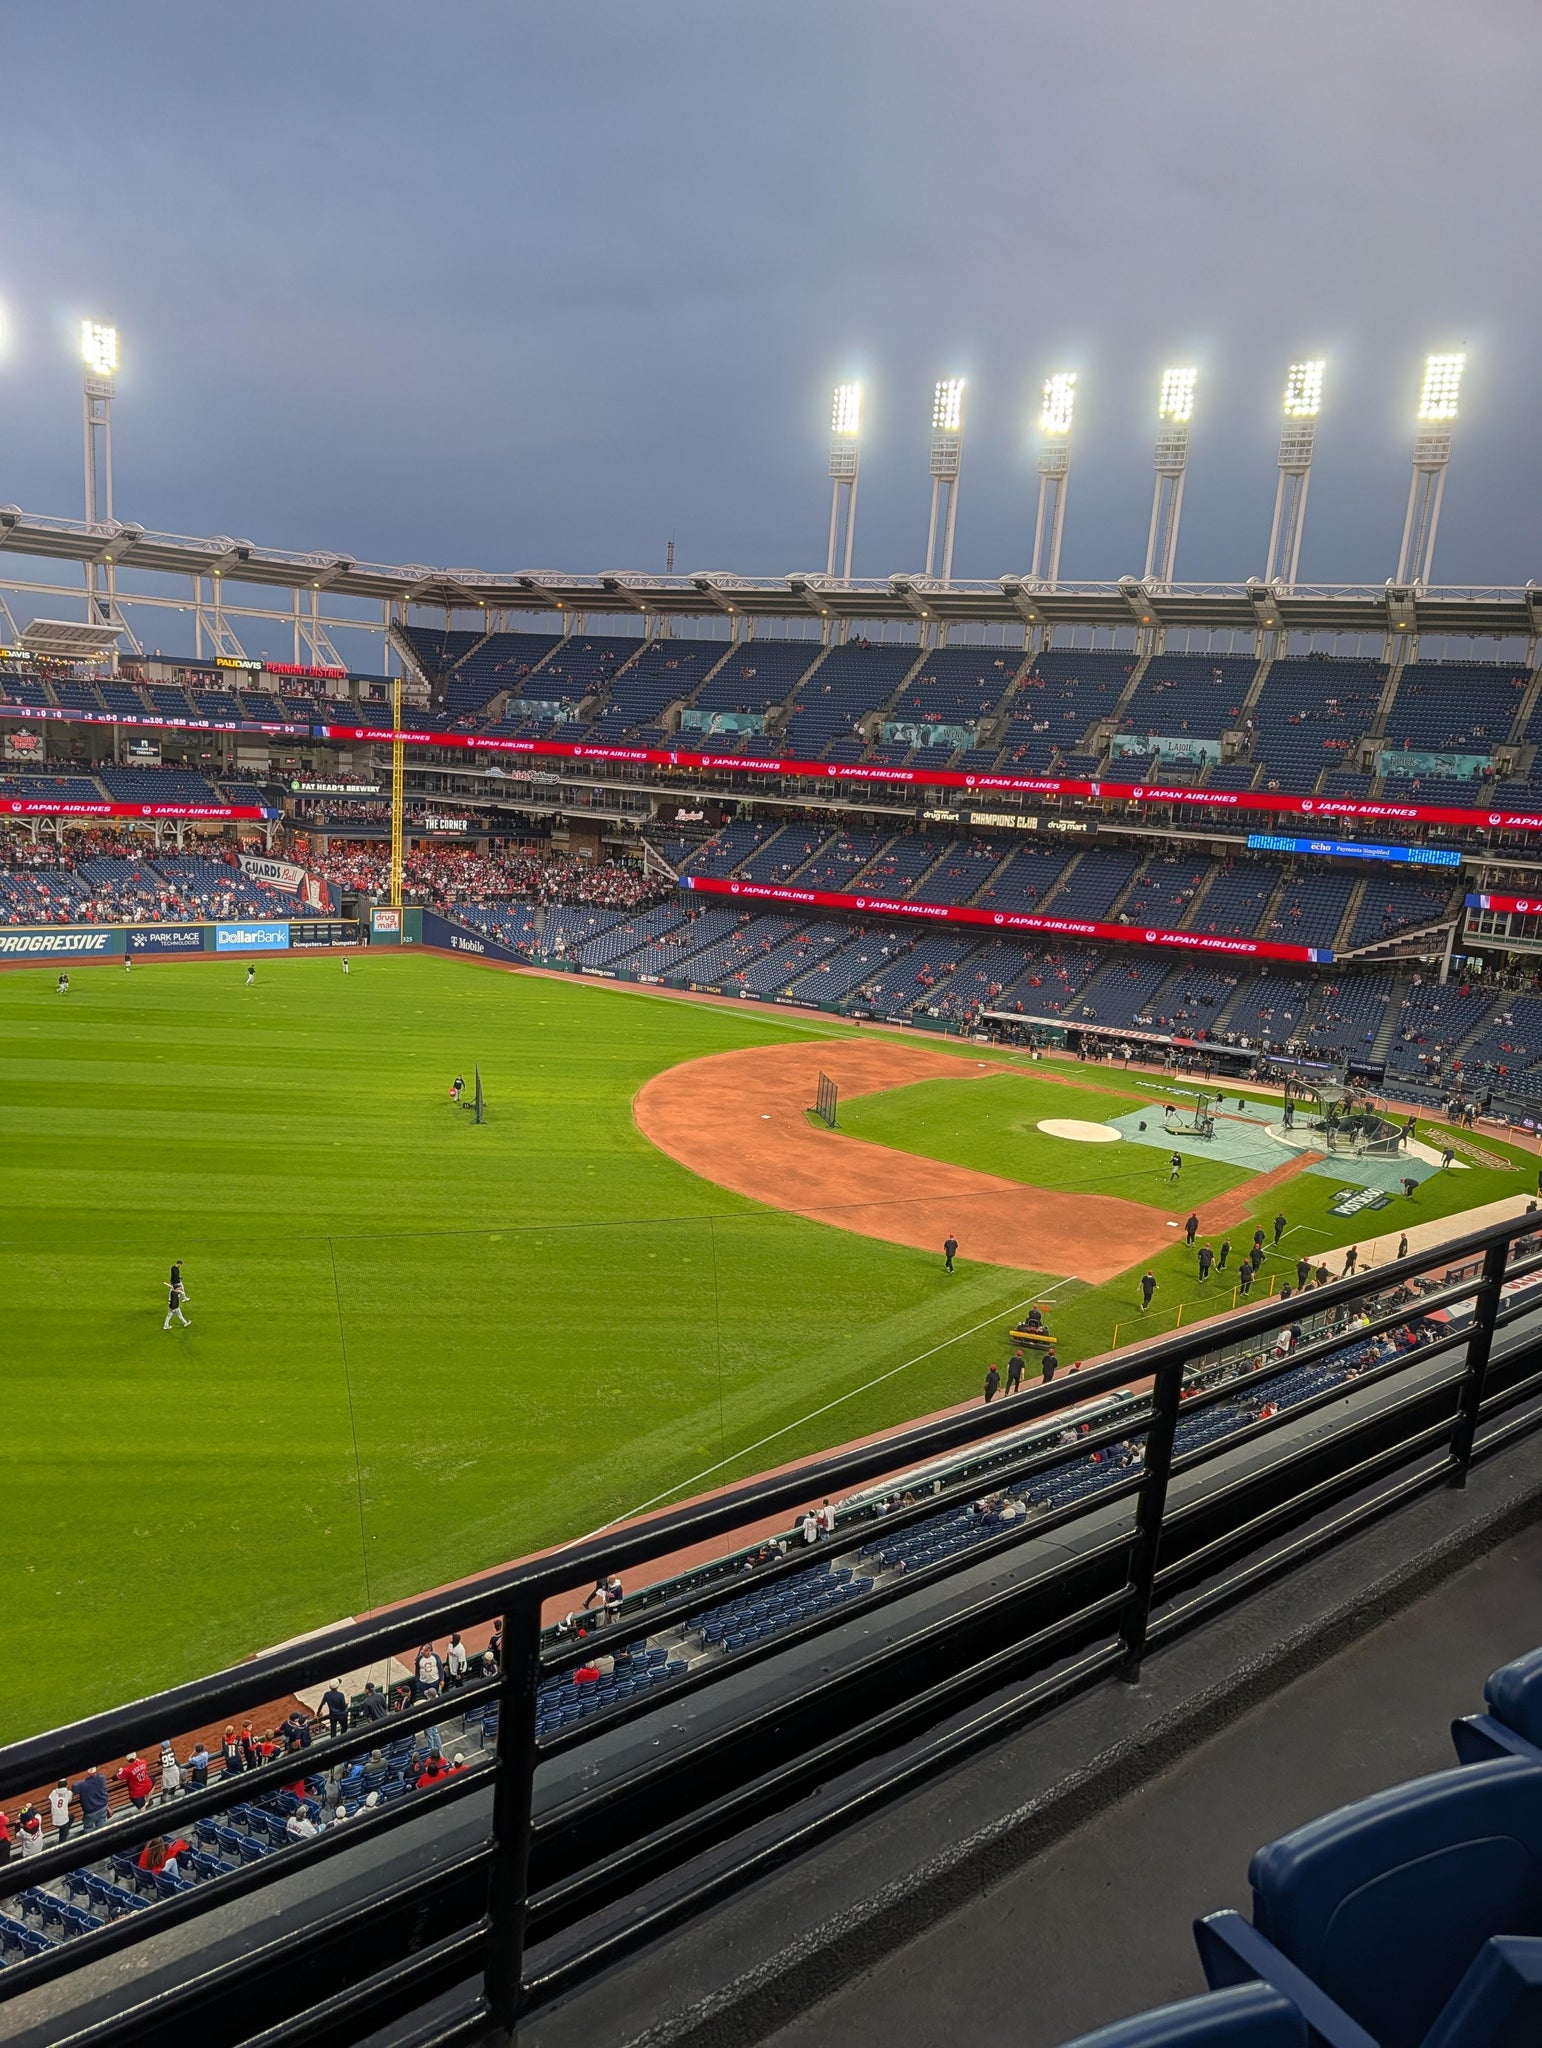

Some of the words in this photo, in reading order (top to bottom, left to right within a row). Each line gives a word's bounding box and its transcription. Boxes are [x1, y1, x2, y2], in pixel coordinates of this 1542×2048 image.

[265, 661, 306, 675] PENNANT
[309, 665, 348, 679] DISTRICT
[499, 741, 534, 750] AIRLINES
[584, 748, 609, 756] JAPAN
[609, 750, 647, 759] AIRLINES
[712, 758, 739, 766] JAPAN
[740, 761, 781, 769] AIRLINES
[839, 768, 869, 776] JAPAN
[869, 770, 914, 779] AIRLINES
[318, 783, 345, 792] HEAD'S
[346, 785, 381, 793] BREWERY
[978, 778, 1011, 786] JAPAN
[1012, 780, 1060, 790] AIRLINES
[1147, 790, 1182, 798] JAPAN
[1184, 793, 1238, 803] AIRLINES
[1317, 802, 1356, 811] JAPAN
[1358, 806, 1418, 816] AIRLINES
[923, 811, 941, 821] drug
[941, 813, 959, 821] mart
[970, 812, 1016, 827] CHAMPIONS
[1016, 816, 1038, 829] CLUB
[425, 819, 439, 830] THE
[440, 819, 467, 831] CORNER
[1048, 821, 1066, 831] drug
[1067, 822, 1087, 831] mart
[1311, 842, 1331, 851] echo
[1336, 846, 1362, 854] Payments
[245, 861, 280, 879] GUARDS
[742, 886, 771, 895] JAPAN
[772, 889, 815, 901] AIRLINES
[869, 901, 900, 910] JAPAN
[901, 904, 949, 916] AIRLINES
[376, 914, 395, 922] drug
[377, 920, 398, 929] mart
[1007, 916, 1042, 926] JAPAN
[1043, 920, 1096, 933] AIRLINES
[150, 933, 172, 941] PARK
[173, 932, 199, 941] PLACE
[1160, 934, 1198, 944] JAPAN
[1200, 938, 1258, 951] AIRLINES
[458, 937, 485, 954] Mobile
[582, 966, 615, 978] Booking.com
[696, 983, 722, 994] BETMGM
[1351, 1062, 1384, 1071] Booking.com
[1334, 1187, 1385, 1215] POSTSEASO
[228, 1744, 236, 1758] 11
[161, 1752, 175, 1768] 95
[57, 1798, 64, 1808] 8
